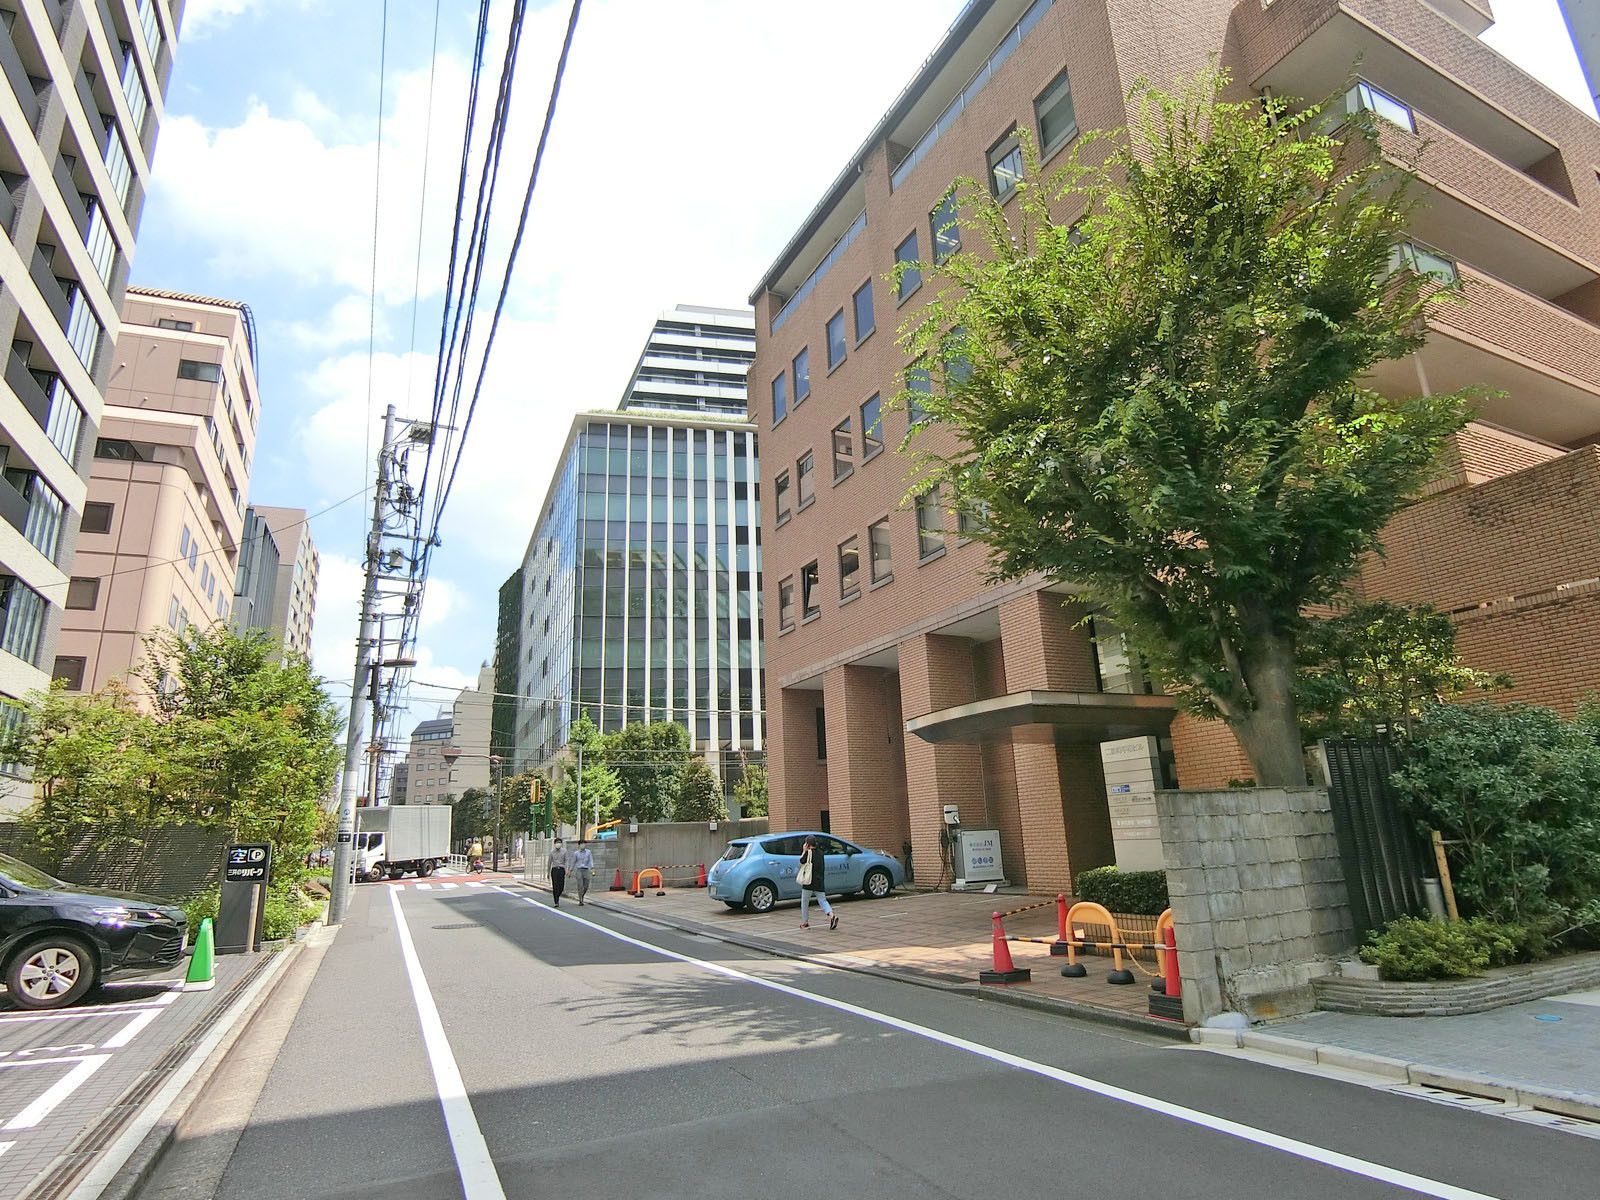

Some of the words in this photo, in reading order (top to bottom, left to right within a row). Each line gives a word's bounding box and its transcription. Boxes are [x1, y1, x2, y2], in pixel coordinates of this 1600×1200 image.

[229, 848, 248, 863] 空
[227, 867, 264, 877] 三井のリパーク
